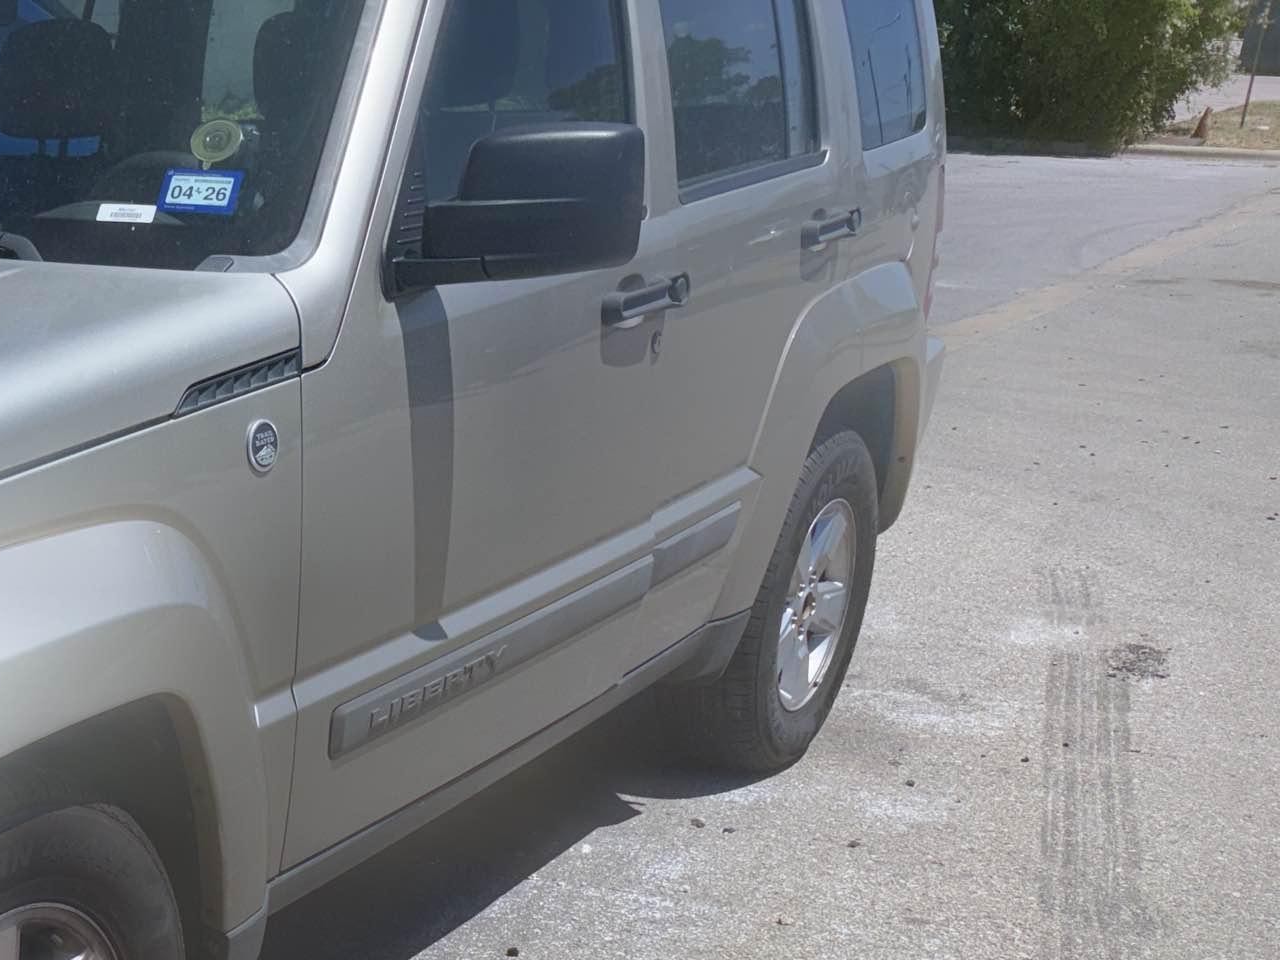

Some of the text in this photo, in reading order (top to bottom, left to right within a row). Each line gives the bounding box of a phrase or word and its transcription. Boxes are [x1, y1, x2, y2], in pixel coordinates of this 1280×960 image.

[170, 185, 228, 202] 04 26
[370, 644, 508, 729] LIBERTY
